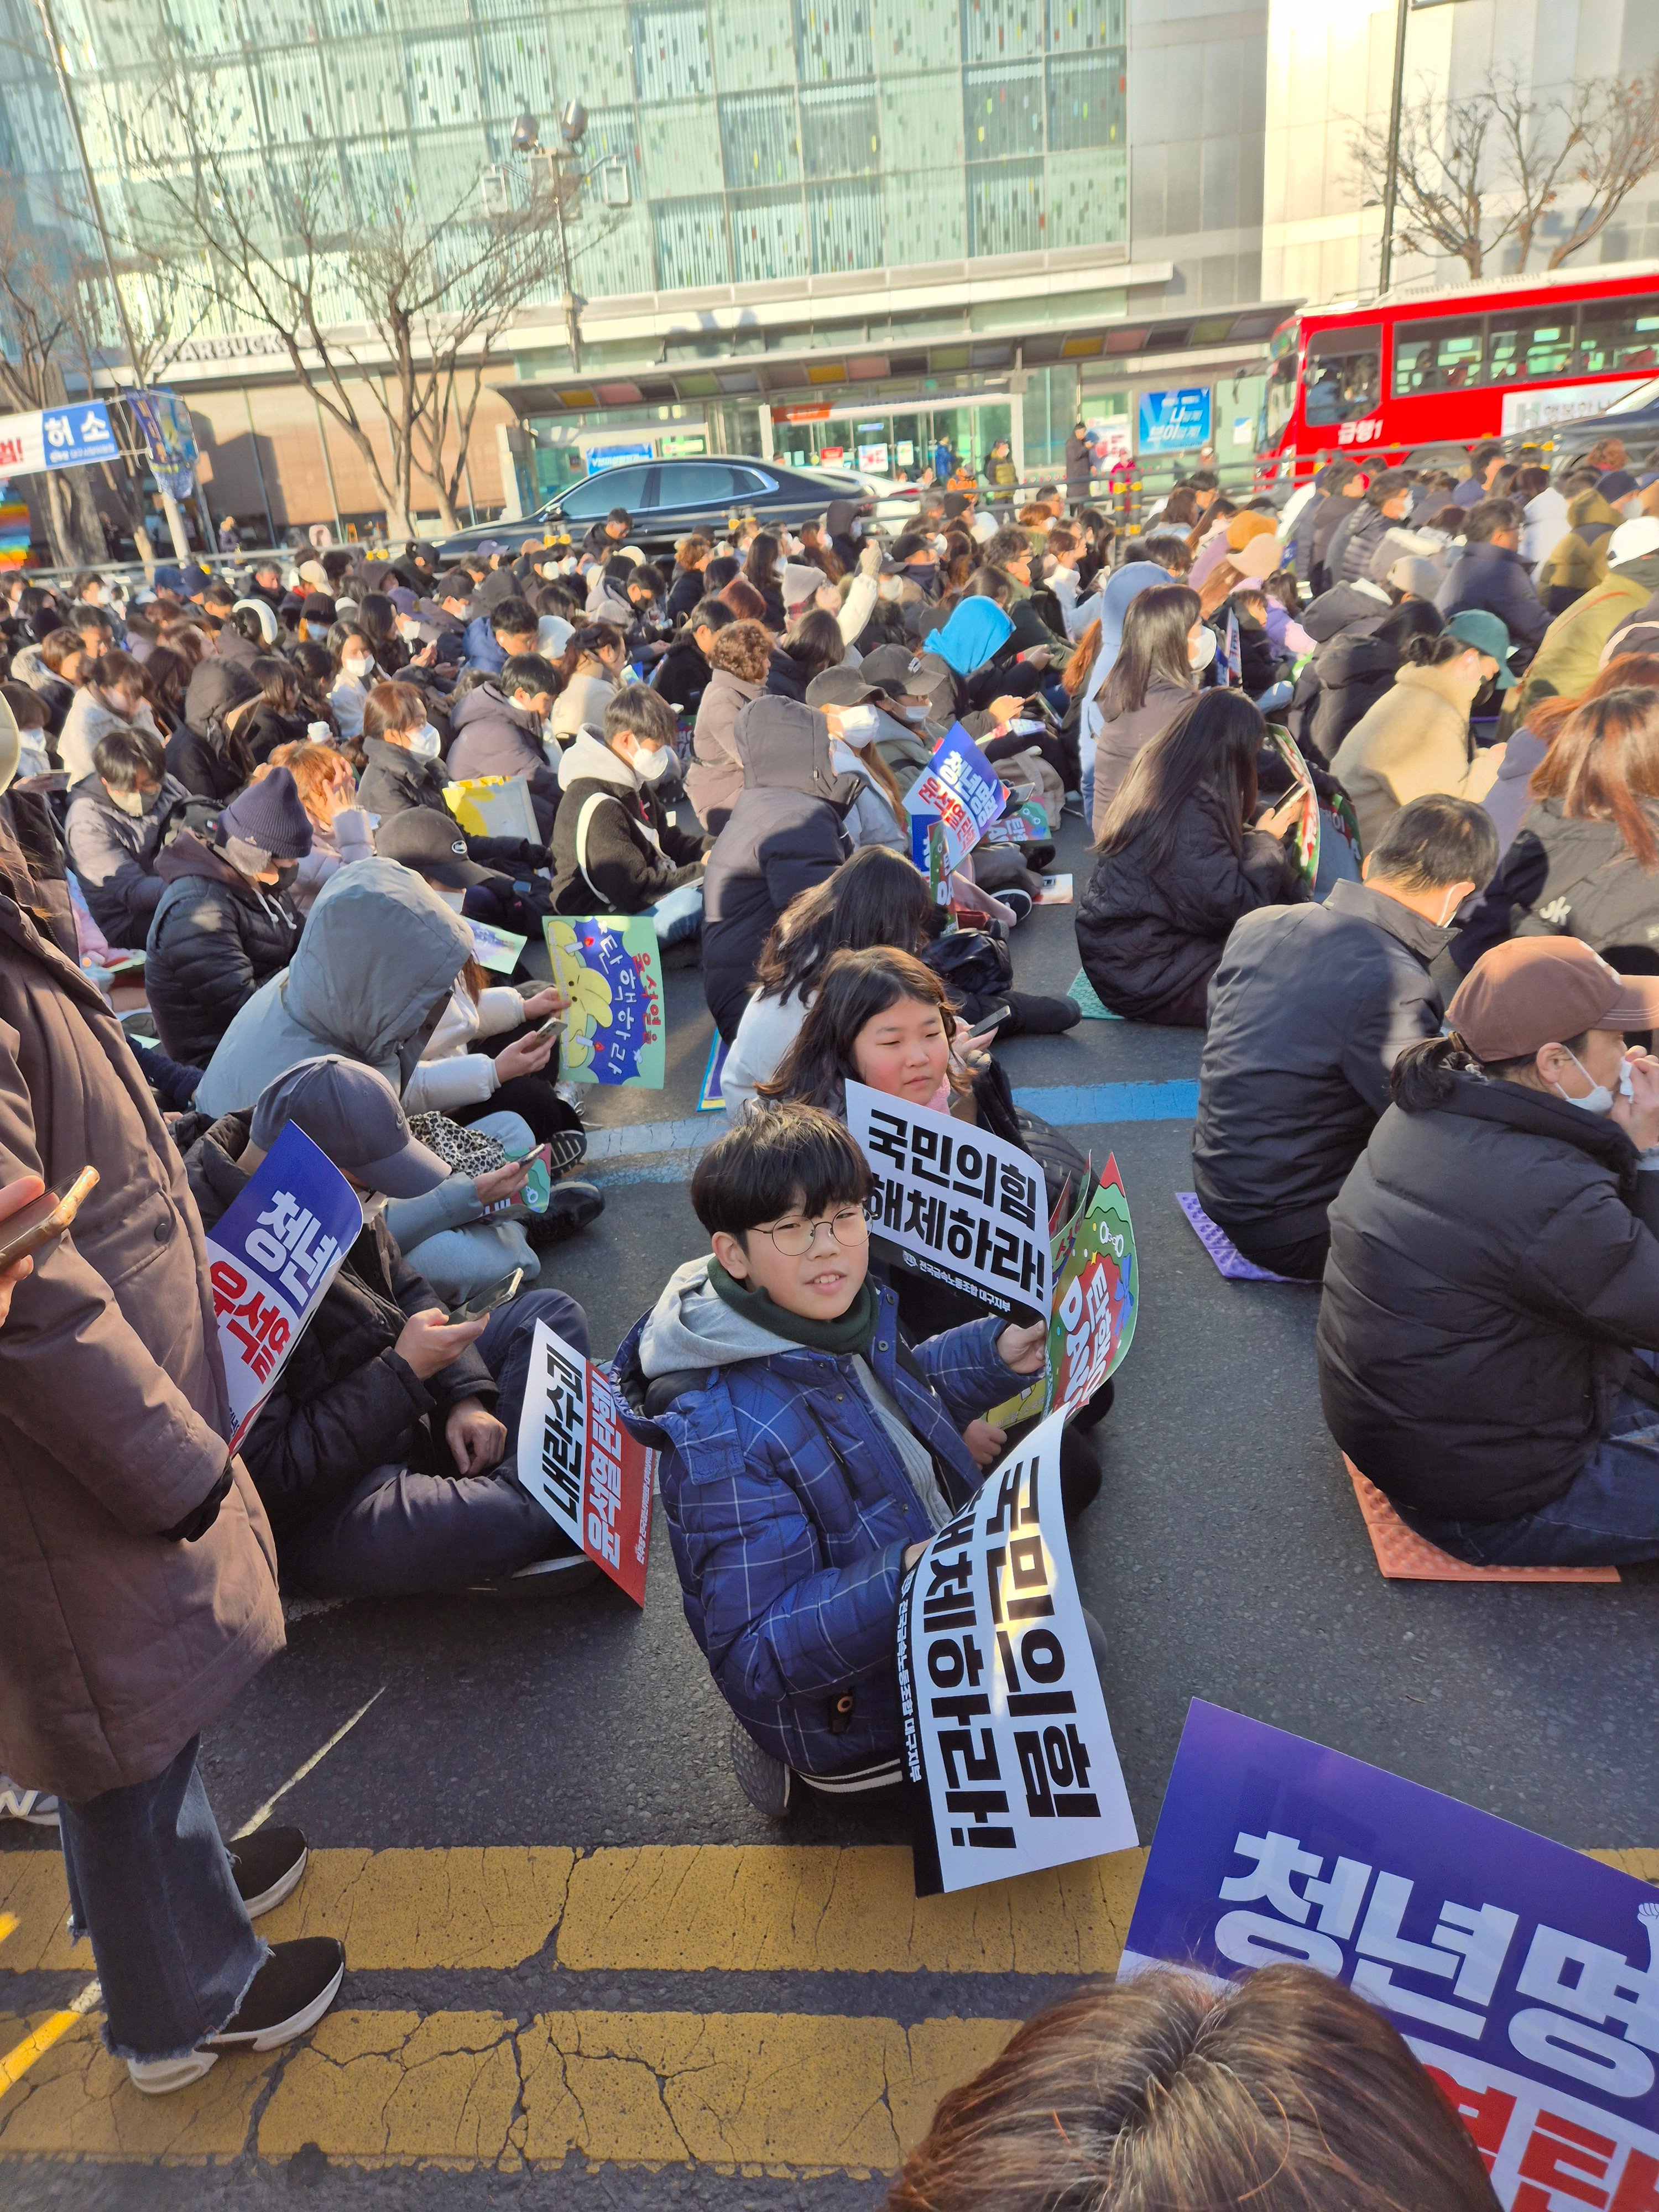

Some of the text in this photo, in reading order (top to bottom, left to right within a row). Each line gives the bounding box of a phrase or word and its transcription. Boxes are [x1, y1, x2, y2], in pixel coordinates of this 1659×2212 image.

[1337, 419, 1384, 445] 급행1
[918, 776, 966, 830] 윤석열
[598, 935, 637, 1076] 탄핵하라
[632, 952, 661, 1045] 윤석열을
[868, 1108, 1037, 1232] 국민의힘
[245, 1190, 341, 1307] 청년
[867, 1173, 1045, 1302] 해체하라!
[919, 1259, 1011, 1313] 전국금속노동조합 대구지부
[542, 1342, 583, 1524] 내란수괴
[588, 1443, 621, 1569] 윤석열
[896, 1599, 922, 1783] 전국금속노동조합 대구지부
[924, 1489, 1018, 1849] 해체하라!
[985, 1456, 1102, 1818] 국민의힘
